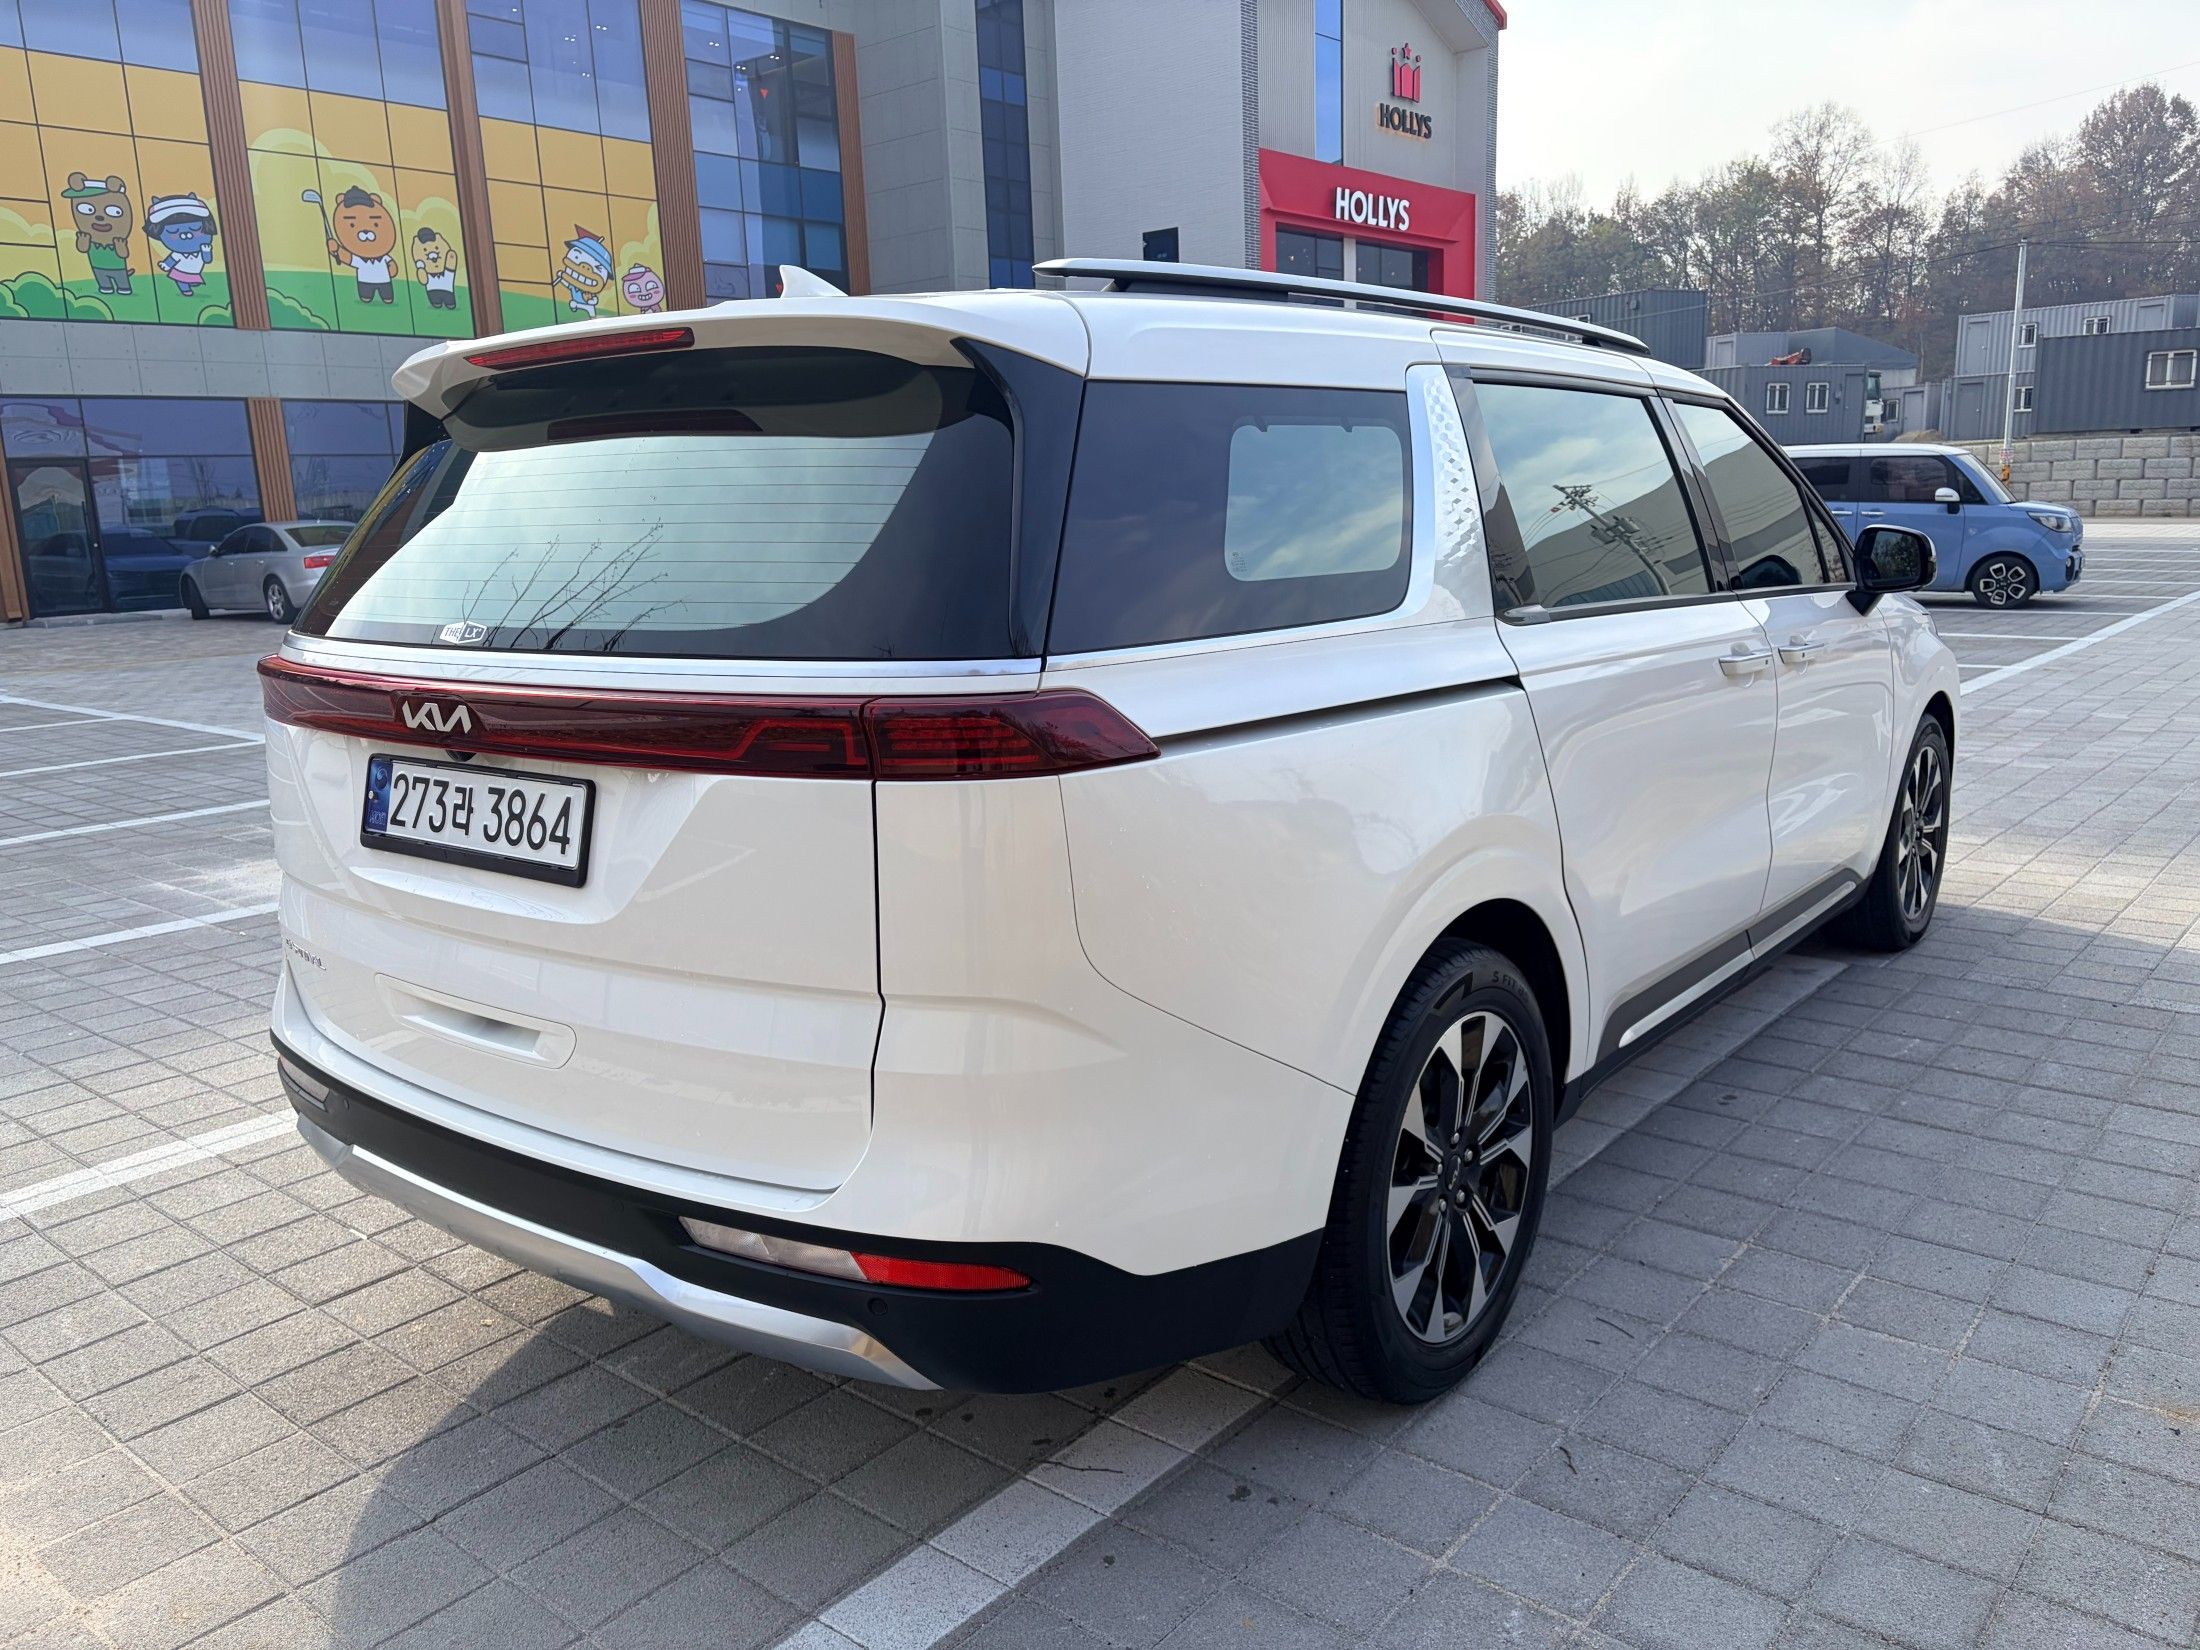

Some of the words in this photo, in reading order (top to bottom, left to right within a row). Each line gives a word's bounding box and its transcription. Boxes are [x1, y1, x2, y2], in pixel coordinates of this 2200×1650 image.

[1379, 103, 1432, 139] HOLLYS
[1335, 187, 1410, 231] HOLLYS
[402, 701, 472, 734] KIA
[389, 773, 474, 836] 273라
[483, 786, 572, 855] 3864
